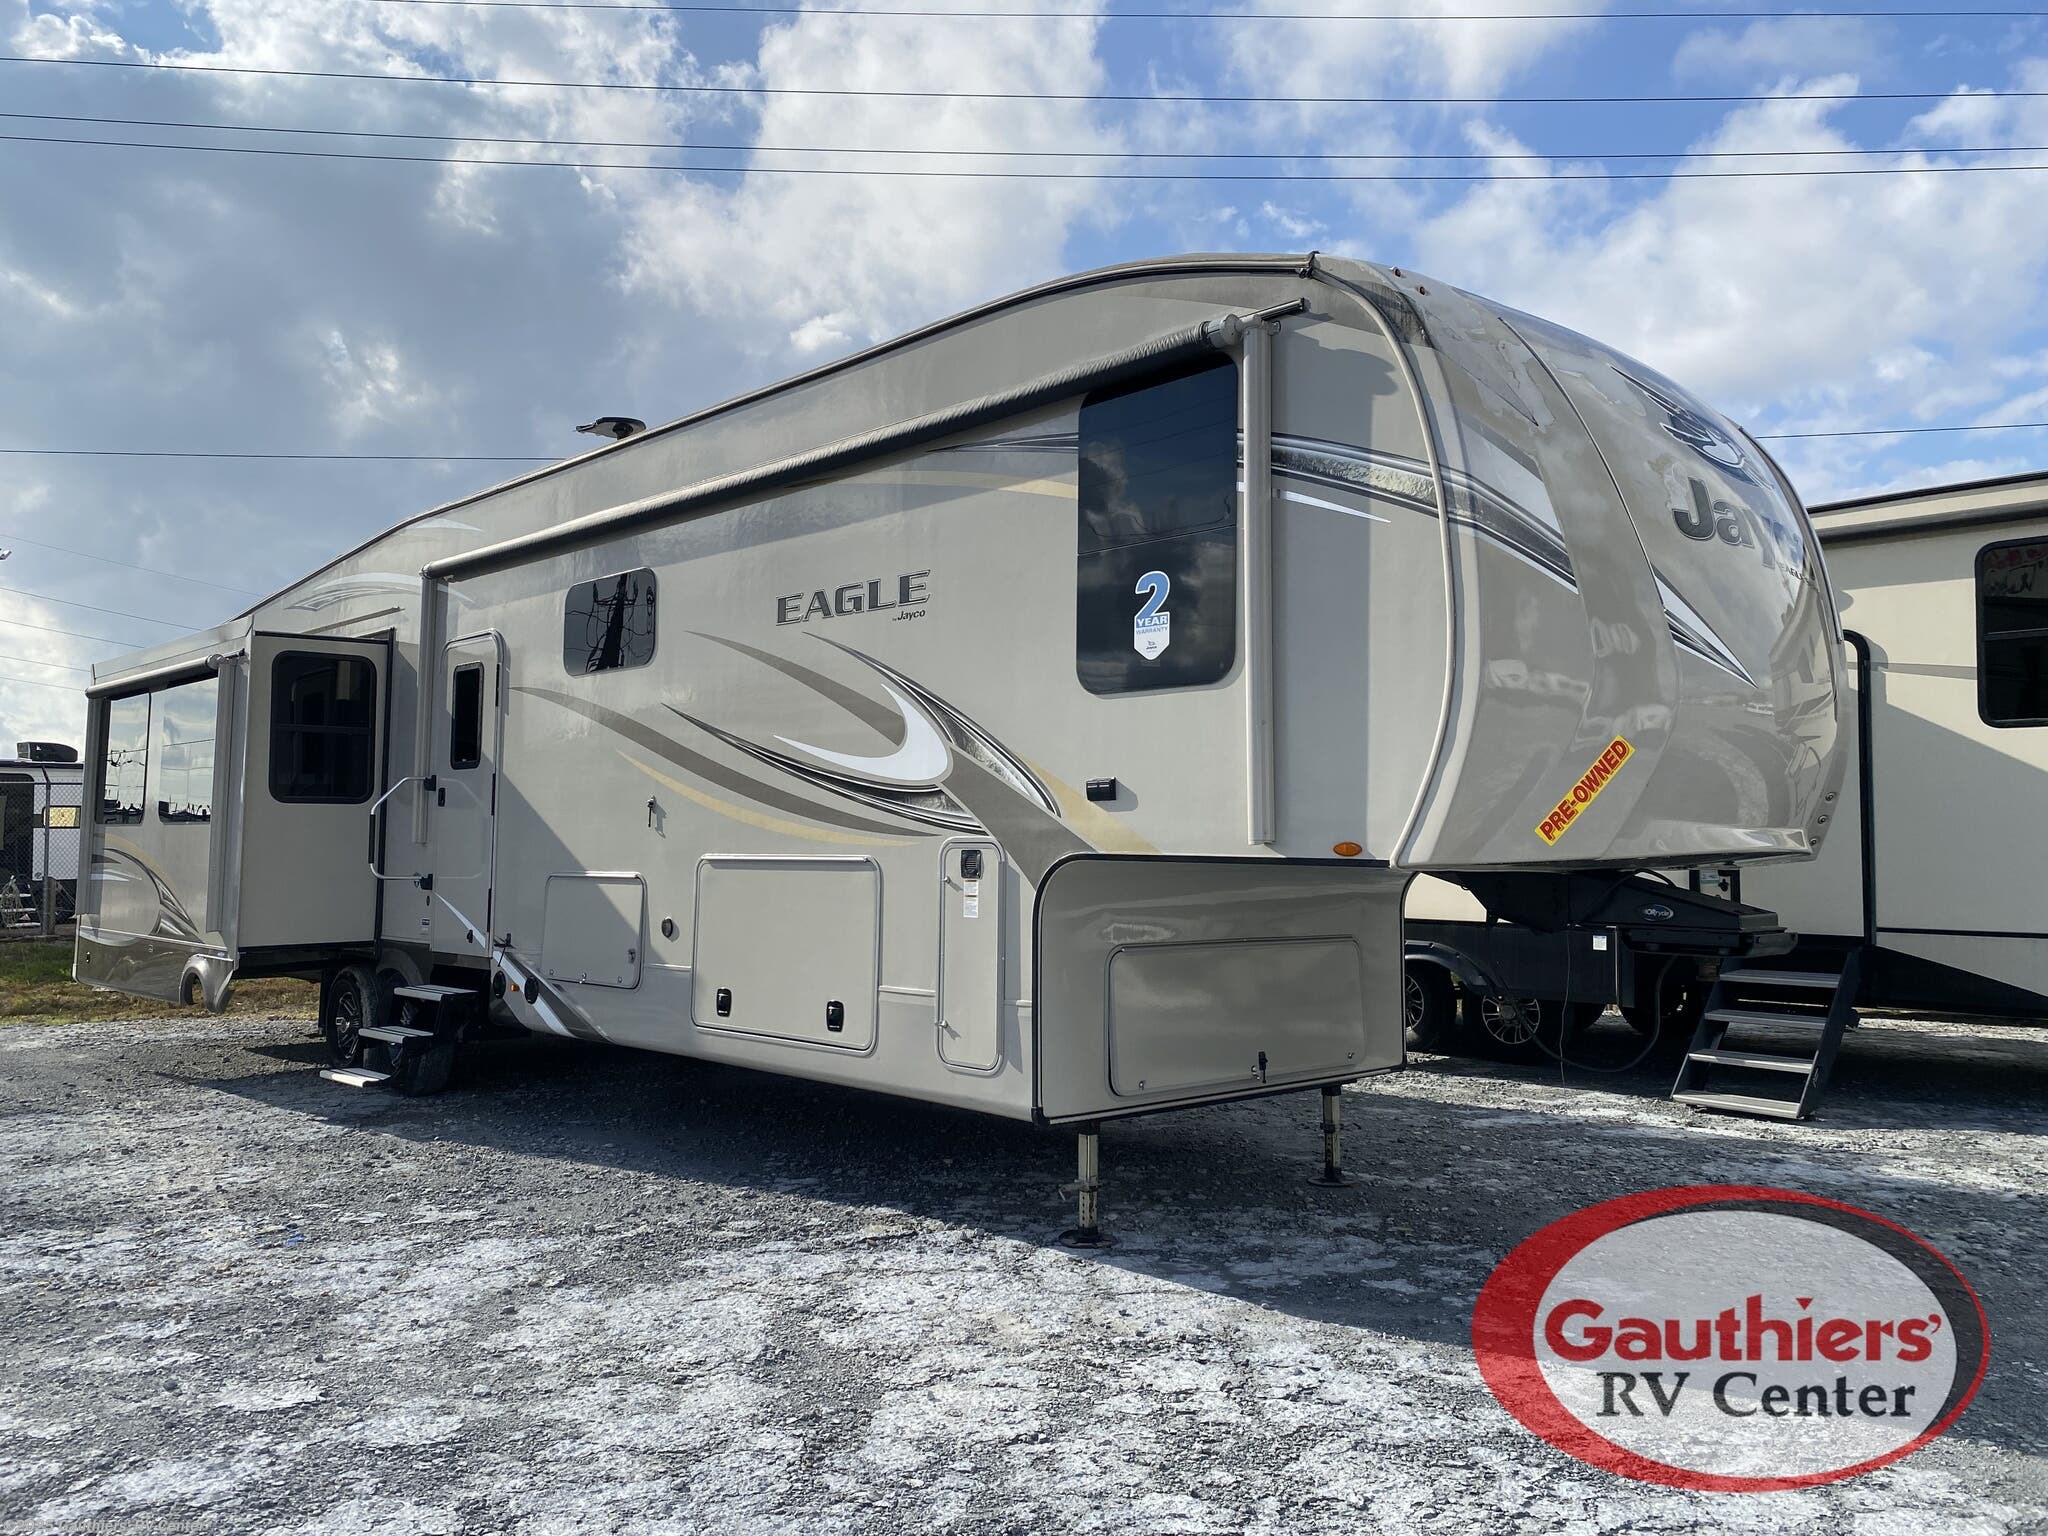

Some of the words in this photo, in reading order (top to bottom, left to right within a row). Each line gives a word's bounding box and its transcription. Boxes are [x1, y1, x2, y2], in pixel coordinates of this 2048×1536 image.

[776, 569, 931, 627] EAGLE
[1135, 570, 1170, 617] 2
[897, 609, 926, 621] Jayco
[1136, 615, 1168, 627] YEAR
[1136, 626, 1168, 635] WARRANTY
[1539, 740, 1630, 841] PRE-OWNED
